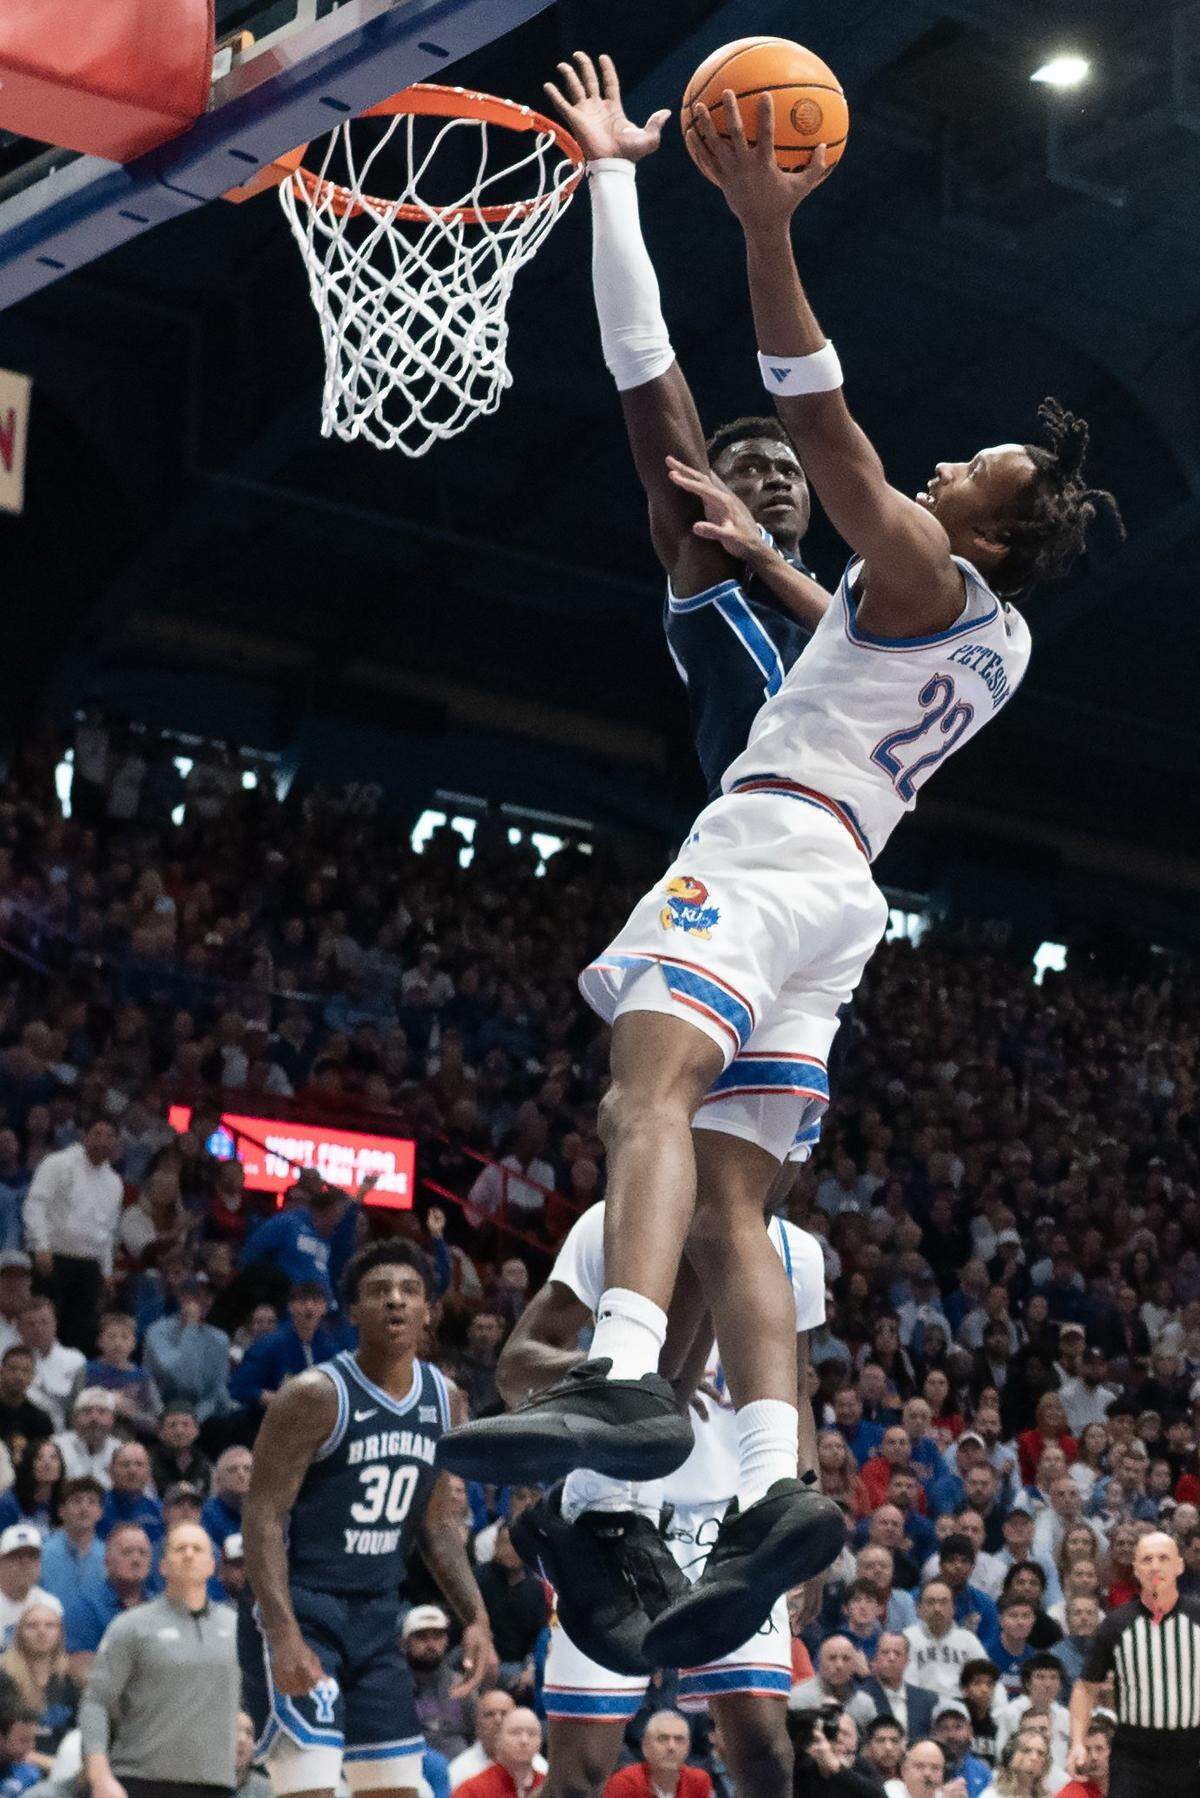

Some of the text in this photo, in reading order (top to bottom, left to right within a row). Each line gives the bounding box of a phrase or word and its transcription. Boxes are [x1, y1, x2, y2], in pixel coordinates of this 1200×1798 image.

[870, 672, 975, 803] 22
[681, 906, 703, 922] KU
[348, 1430, 437, 1466] BRIGHAM
[350, 1464, 419, 1524] 30
